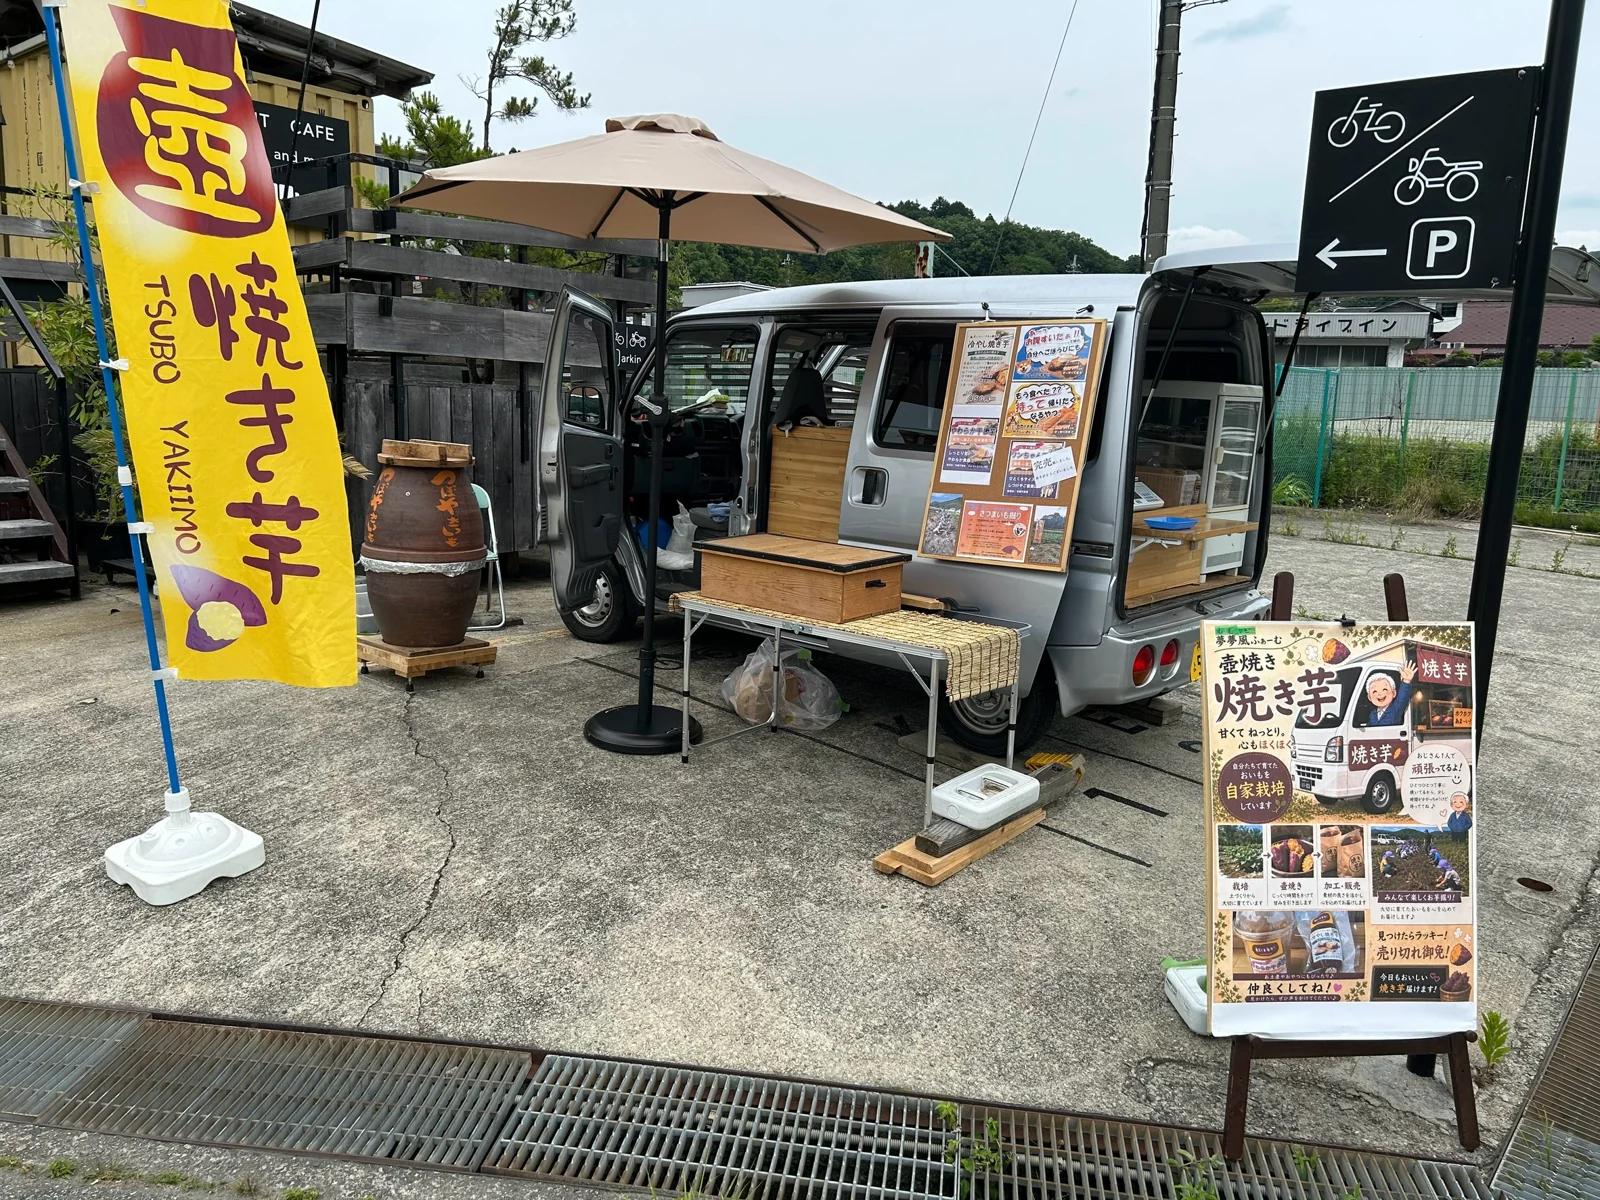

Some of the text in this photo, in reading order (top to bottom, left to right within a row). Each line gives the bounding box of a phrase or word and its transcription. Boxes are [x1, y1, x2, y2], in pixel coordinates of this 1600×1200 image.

[290, 119, 335, 142] CAFE
[1426, 230, 1458, 268] P
[1265, 318, 1397, 333] ドライブイン
[967, 340, 1010, 349] 冷やし焼き芋
[1026, 345, 1081, 359] 自分へごほうびにも
[1016, 399, 1045, 413] 持って
[144, 275, 202, 554] TSUBO YAKIIMO
[979, 510, 1021, 520] さつまいも掘り
[1215, 635, 1283, 647] 夢夢風ふぁーむ
[1219, 652, 1276, 674] 壺焼き
[1421, 659, 1468, 682] 焼き芋
[1214, 667, 1338, 725] 焼き芋
[1218, 727, 1286, 739] 甘くて ねっとり。
[1238, 740, 1297, 750] 心もほくほく。
[1351, 744, 1393, 765] 焼き芋
[1232, 762, 1278, 770] 自分たちで育てた
[1411, 762, 1463, 775] 頑張ってるよ!
[1240, 771, 1271, 780] おいもを
[1226, 780, 1286, 800] 自家栽培
[1240, 801, 1272, 811] しています
[1232, 881, 1249, 891] 栽培
[1384, 893, 1456, 902] みんなで楽しくお芋掘り!
[1377, 930, 1448, 942] 見つけたらラッキー!
[1376, 945, 1450, 961] 売り切れ御免!
[1379, 972, 1428, 982] 今日もおいしい
[1247, 982, 1332, 994] 仲良くしてね!
[1379, 983, 1437, 994] 焼き芋届けます!
